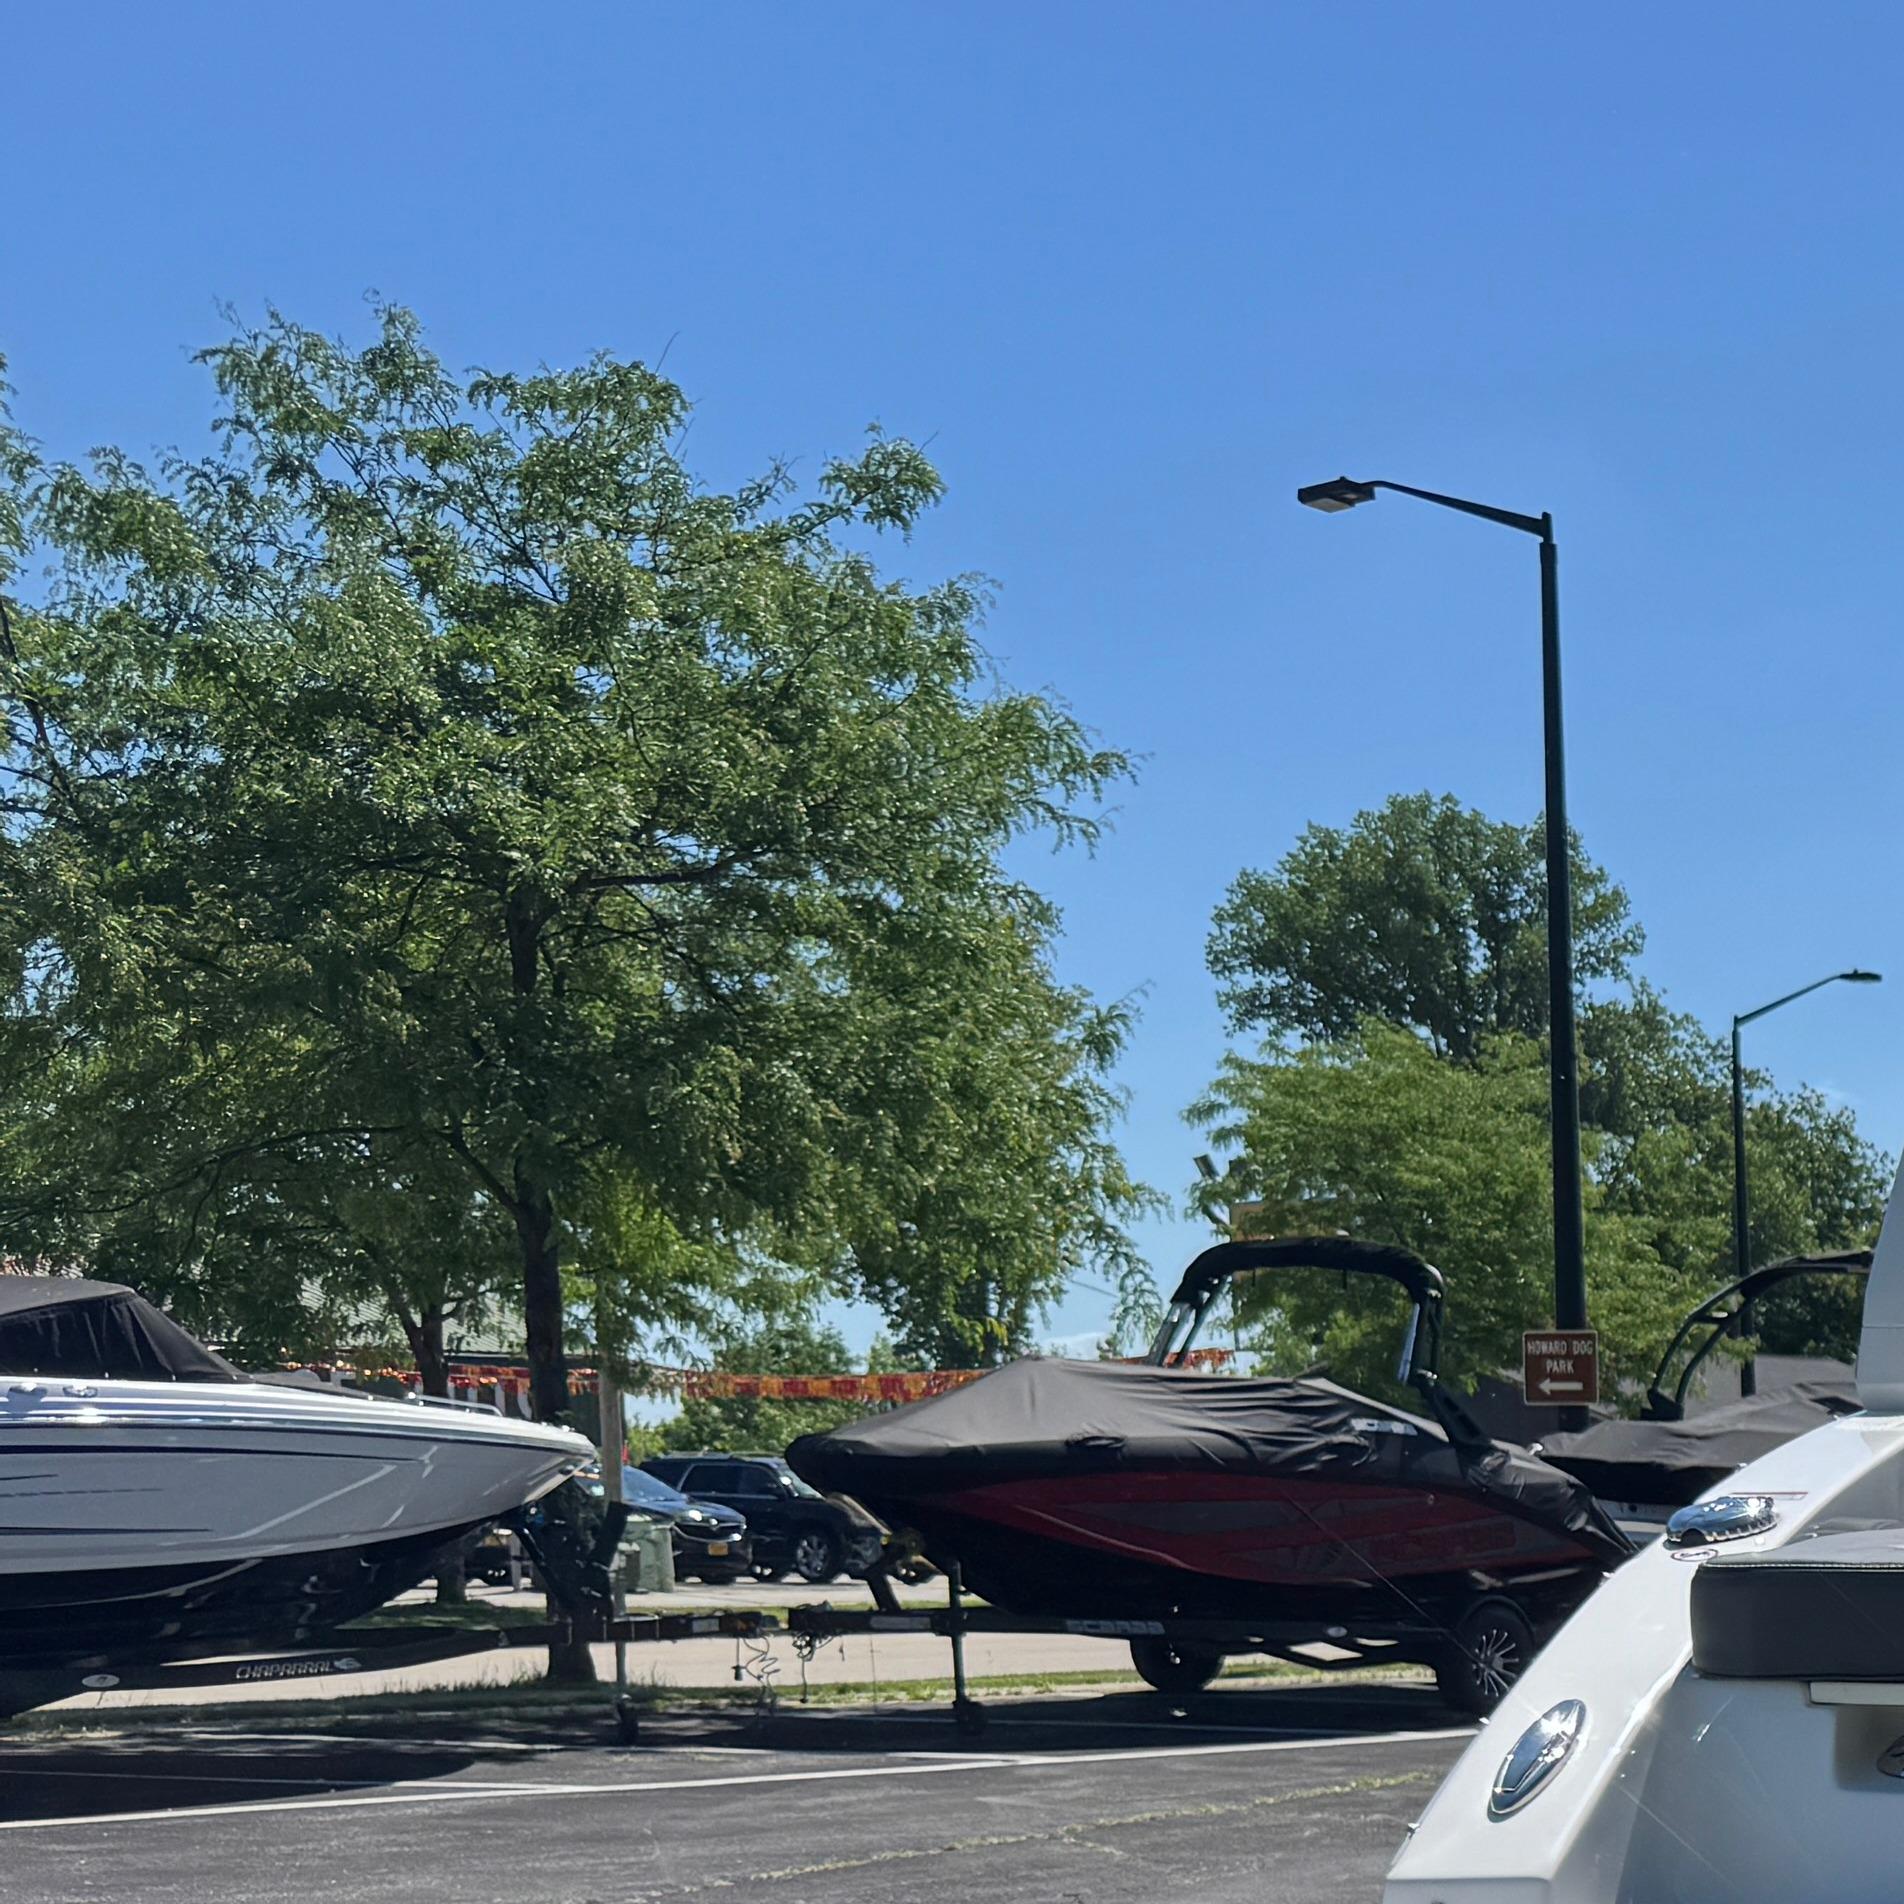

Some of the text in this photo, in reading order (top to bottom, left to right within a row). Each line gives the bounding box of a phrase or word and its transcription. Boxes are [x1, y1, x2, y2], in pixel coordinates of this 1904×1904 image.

[1527, 1341, 1593, 1355] HOWARD DOG
[1546, 1359, 1574, 1374] PARK
